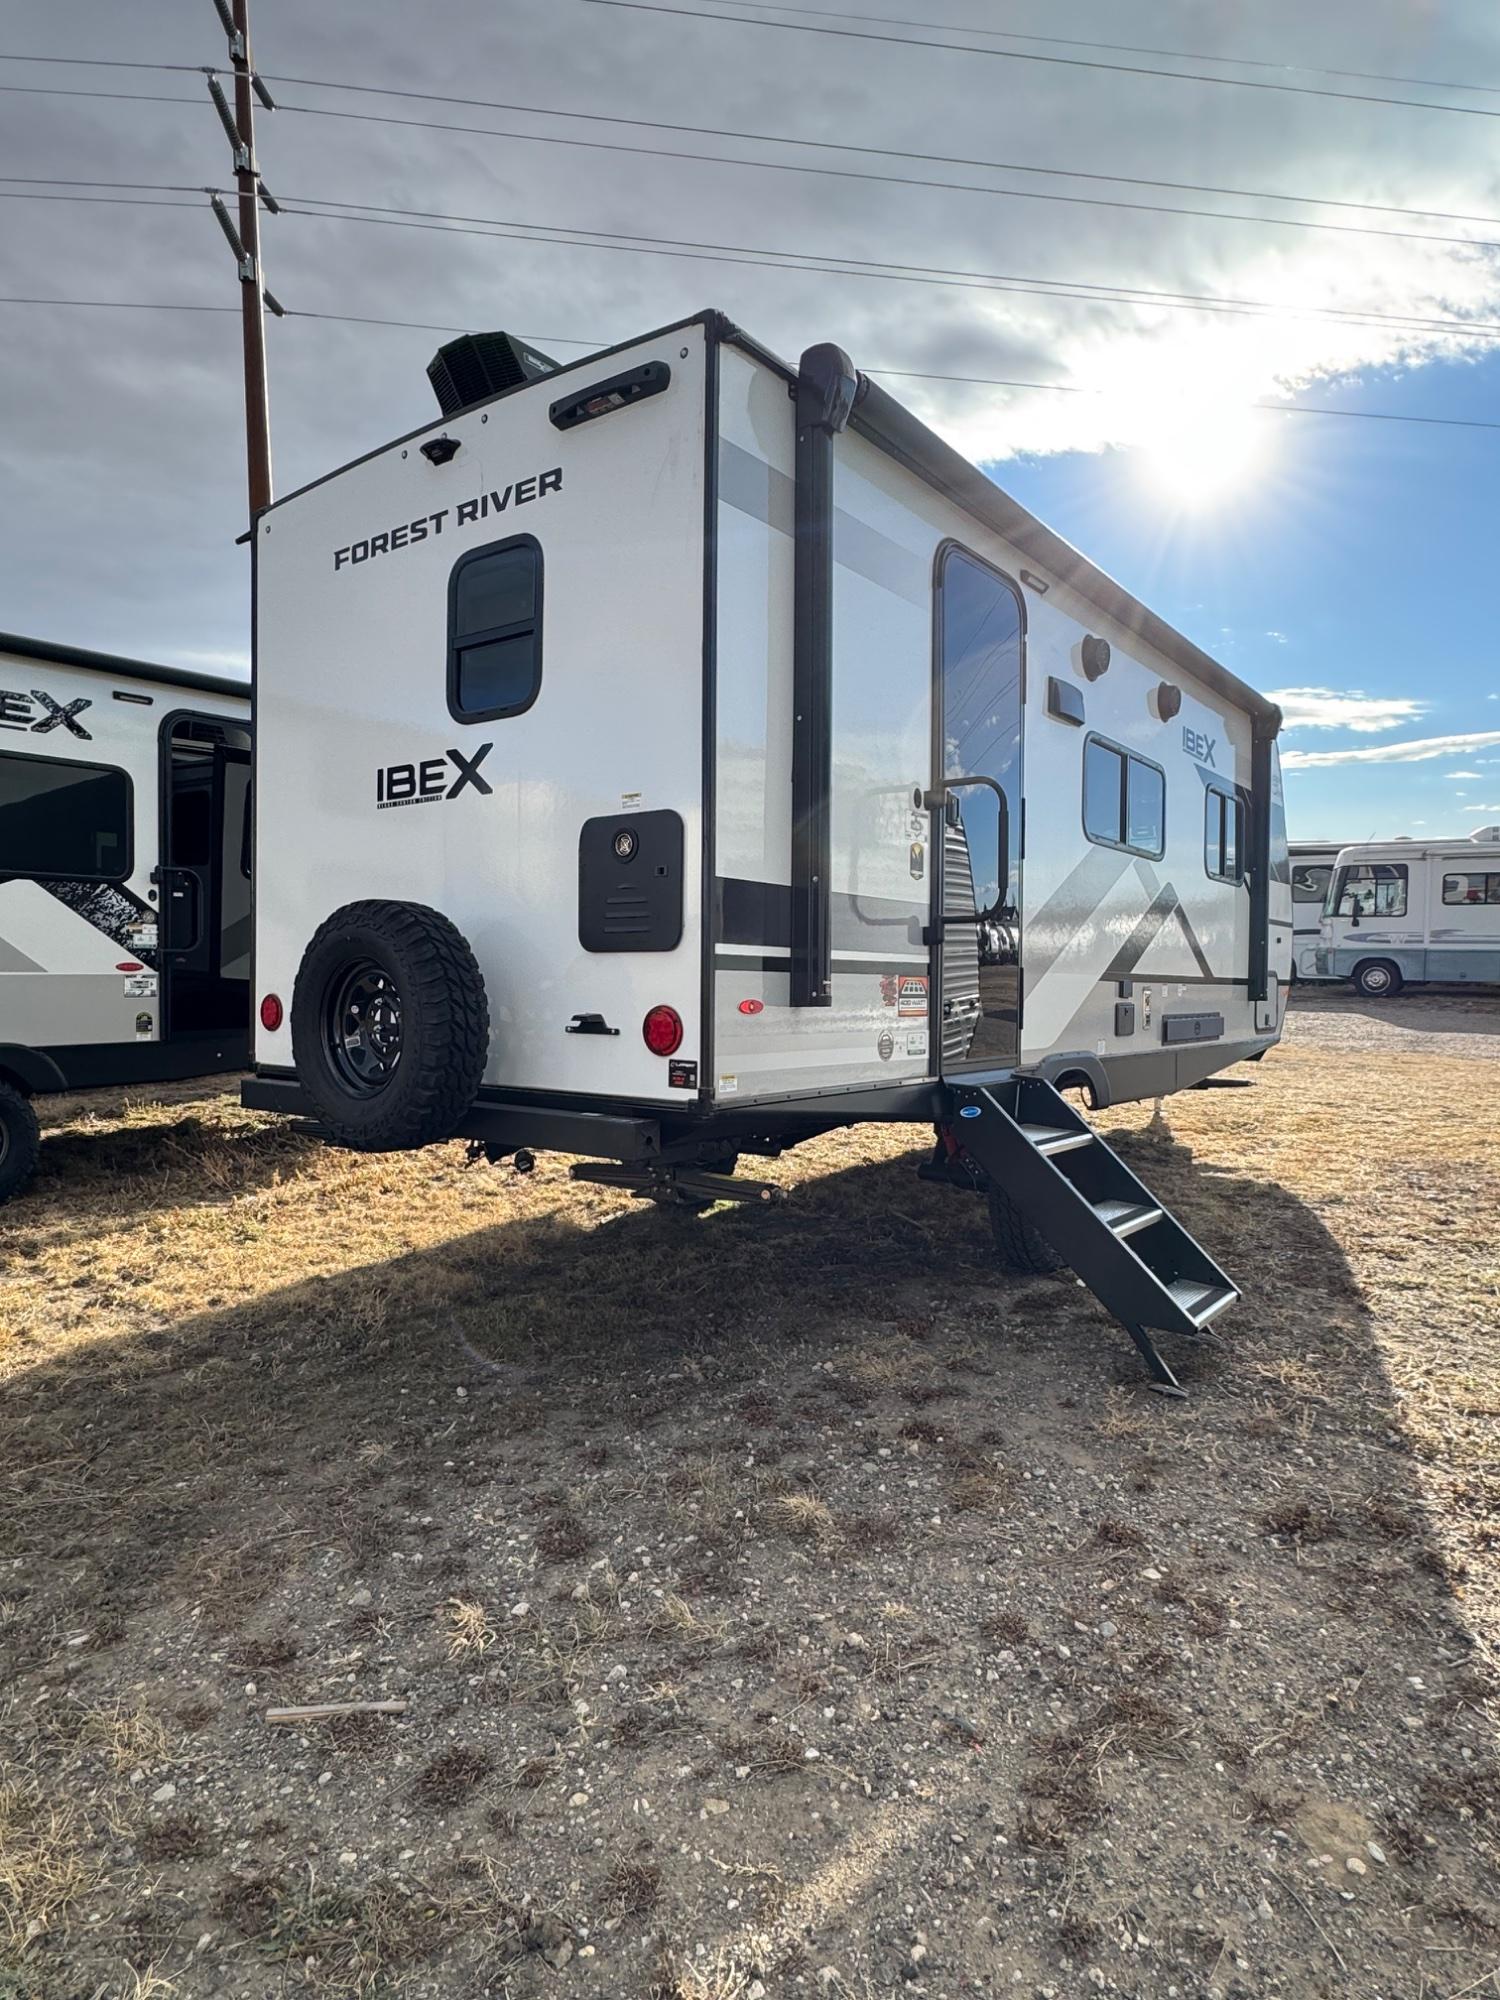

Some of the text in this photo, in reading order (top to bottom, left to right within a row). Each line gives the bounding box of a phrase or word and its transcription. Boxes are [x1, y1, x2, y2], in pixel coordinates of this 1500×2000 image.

[334, 467, 563, 571] FOREST RIVER
[377, 742, 494, 802] IBEX
[1182, 726, 1216, 768] IBEX
